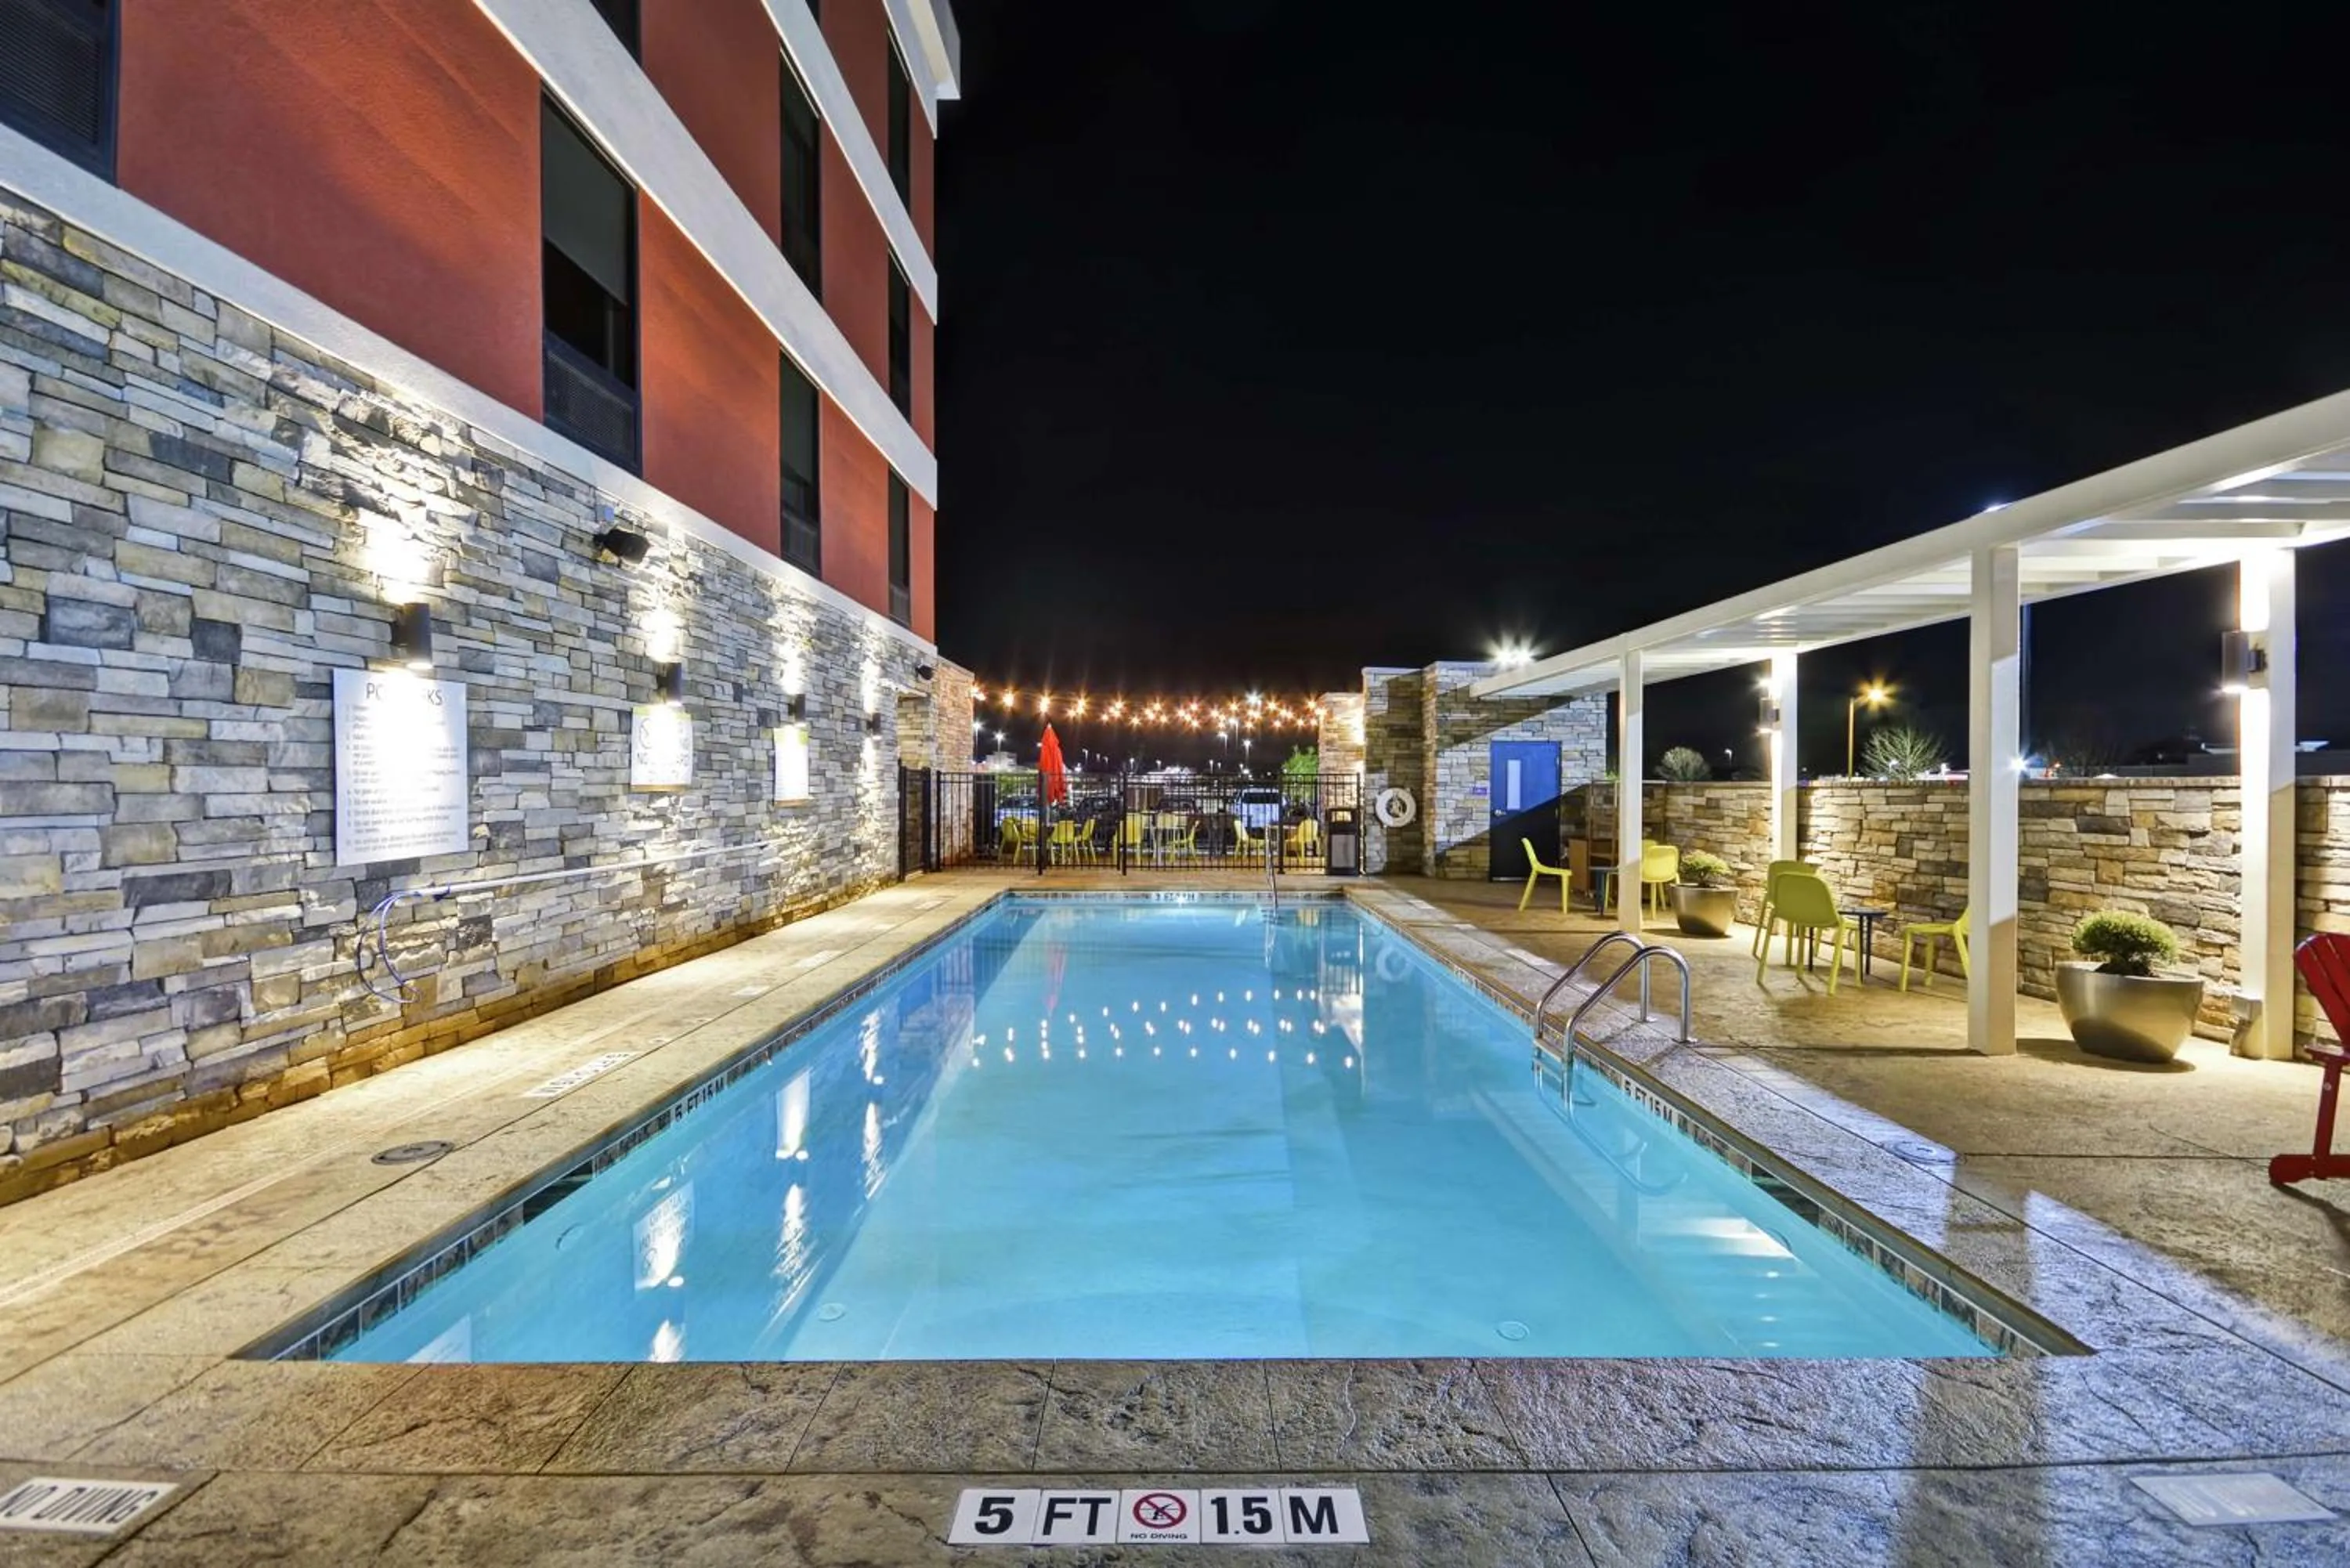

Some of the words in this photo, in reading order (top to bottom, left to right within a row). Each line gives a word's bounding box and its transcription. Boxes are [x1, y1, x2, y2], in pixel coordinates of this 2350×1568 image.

[688, 1093, 700, 1113] FT
[1635, 1087, 1647, 1105] FT
[1663, 1105, 1672, 1125] M
[31, 1486, 158, 1523] DIVING
[974, 1497, 1016, 1534] 5
[1043, 1497, 1112, 1535] FT
[1210, 1497, 1273, 1534] 1.5
[1289, 1496, 1339, 1534] M
